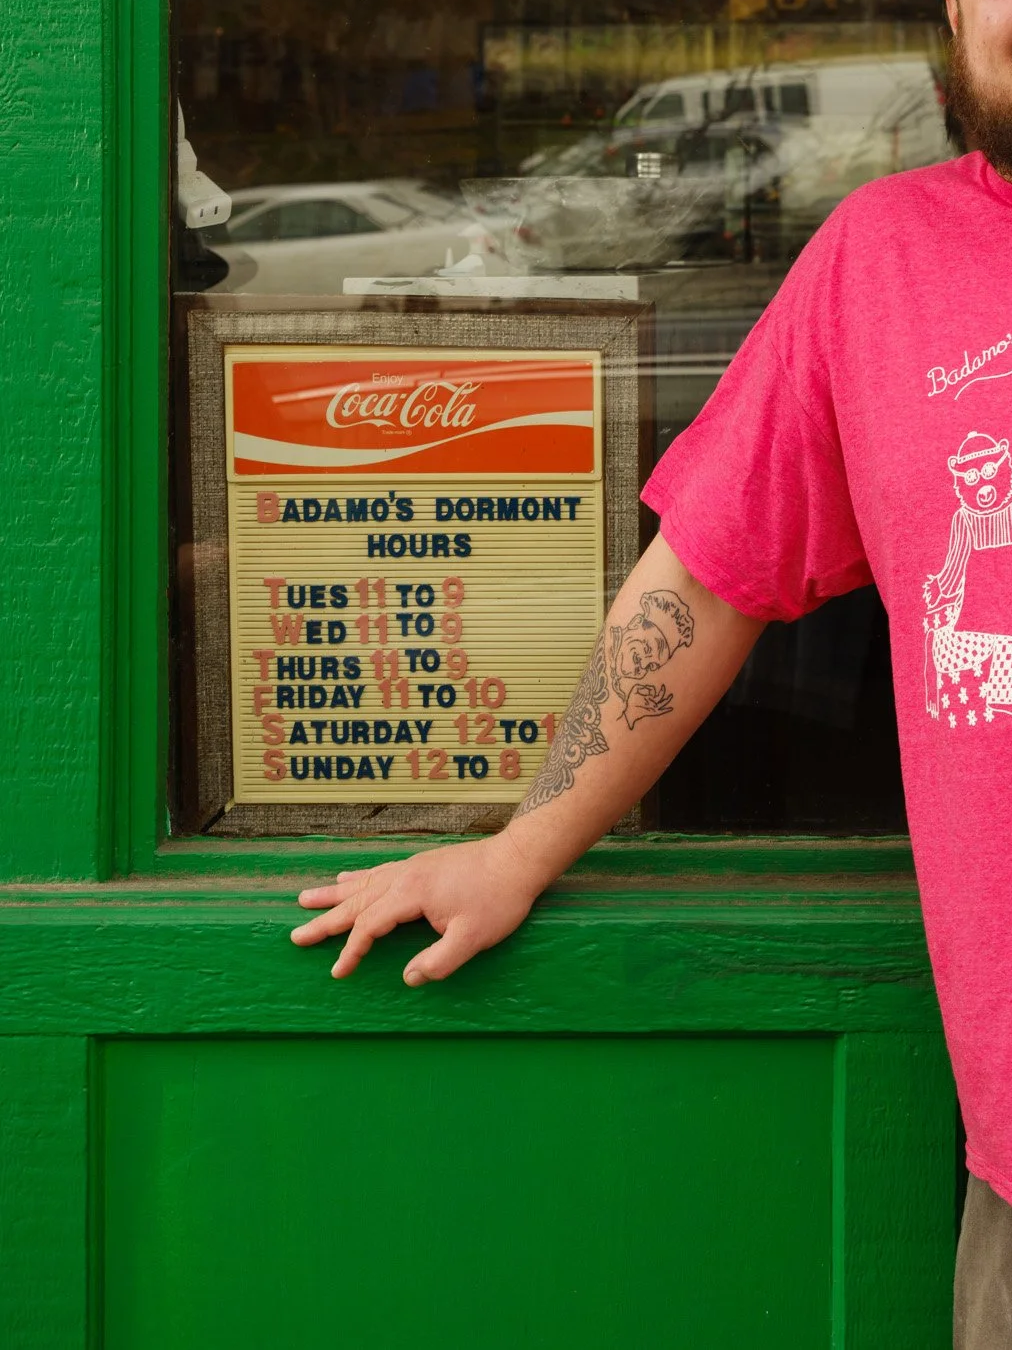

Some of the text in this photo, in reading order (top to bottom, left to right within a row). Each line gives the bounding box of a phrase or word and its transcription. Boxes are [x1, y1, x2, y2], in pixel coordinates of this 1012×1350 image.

[372, 372, 404, 386] Enjoy
[325, 381, 483, 429] Coca-Cola
[256, 491, 582, 523] BADAMO'S DORMONT
[367, 533, 472, 558] HOURS
[263, 576, 465, 609] TUES 11 TO 9
[270, 612, 464, 645] WED 11 TO 9
[252, 648, 468, 681] THURS 11 TO 9
[253, 677, 506, 716] FRIDAY 11 TO 10
[261, 713, 433, 745] SATURDAY
[453, 713, 497, 745] 12
[500, 720, 538, 743] TO
[262, 748, 521, 781] SUNDAY 12 TO 8
